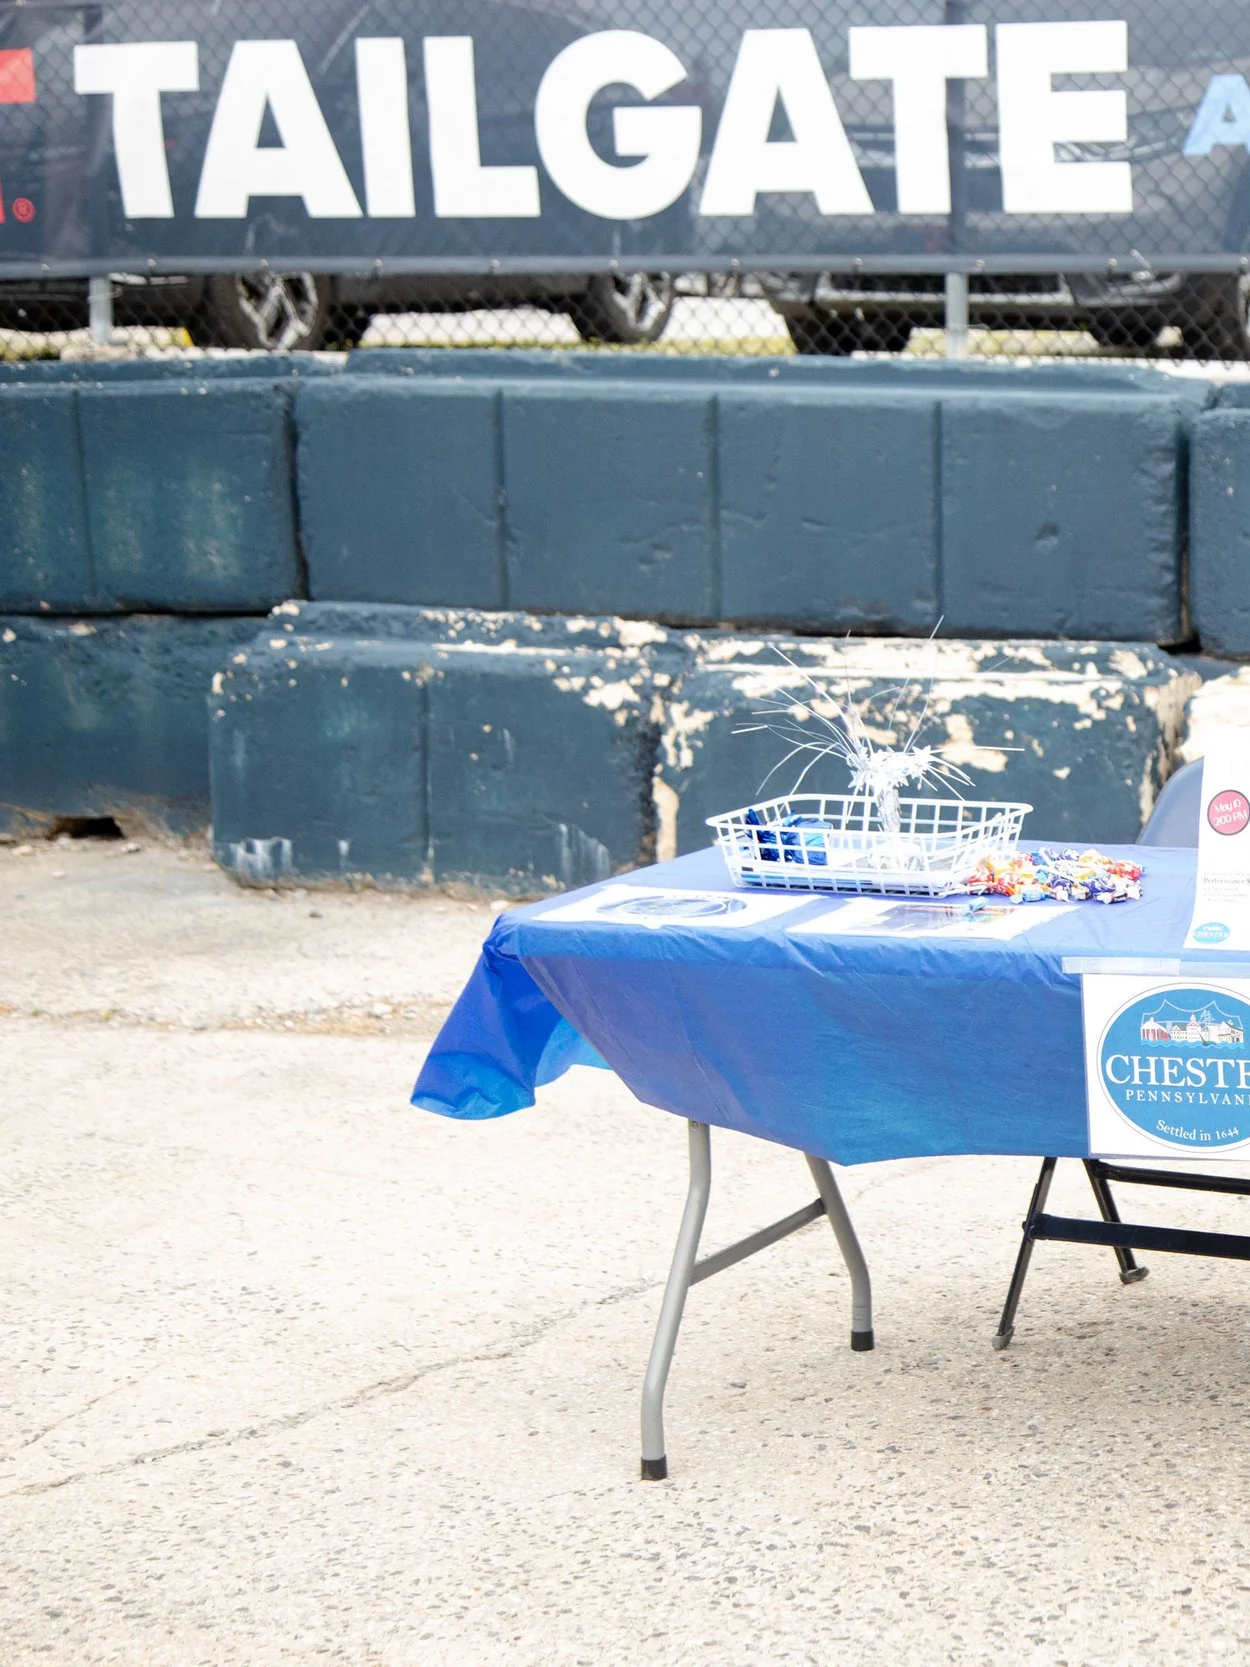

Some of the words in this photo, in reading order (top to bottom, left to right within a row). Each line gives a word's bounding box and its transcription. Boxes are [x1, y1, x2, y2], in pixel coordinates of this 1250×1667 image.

[74, 20, 1133, 220] TAILGATE
[1156, 1119, 1197, 1141] Settled
[1200, 1130, 1211, 1141] in
[1215, 1126, 1239, 1140] 1644
